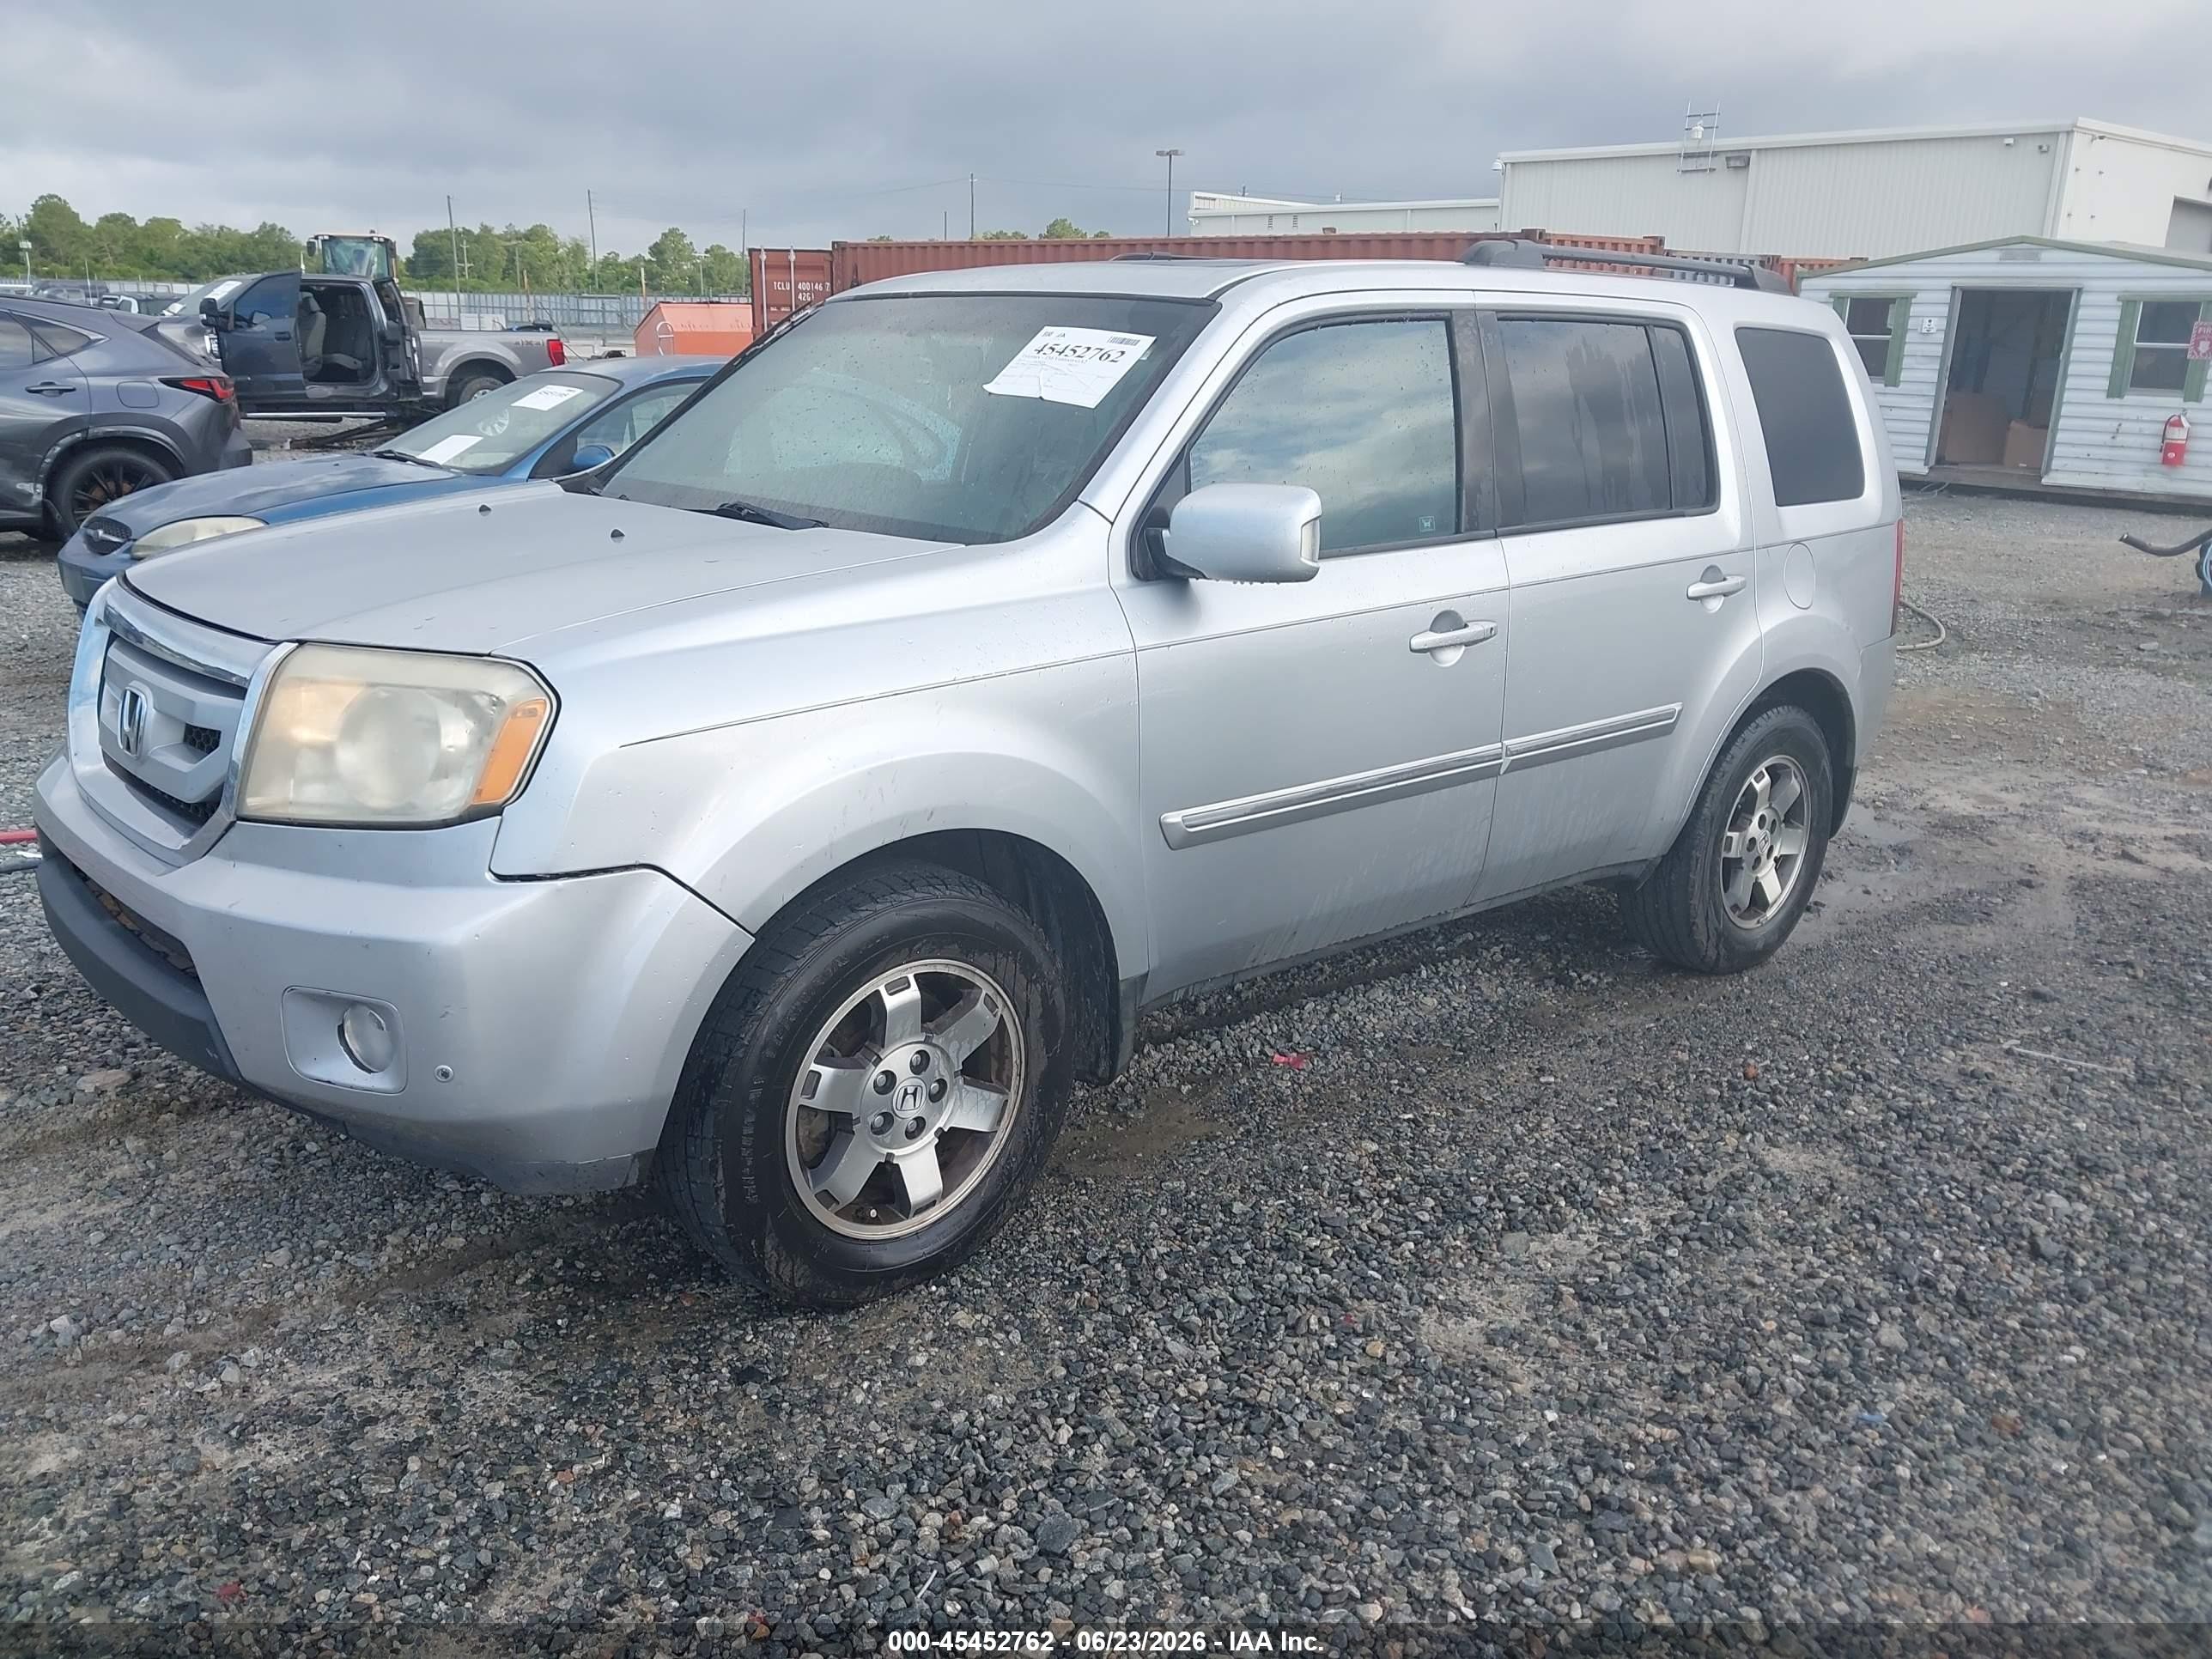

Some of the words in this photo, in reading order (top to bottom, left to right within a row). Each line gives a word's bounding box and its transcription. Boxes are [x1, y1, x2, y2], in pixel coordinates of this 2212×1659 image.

[773, 281, 790, 290] TCLU
[797, 282, 823, 291] 400146
[1034, 343, 1127, 363] 45452762
